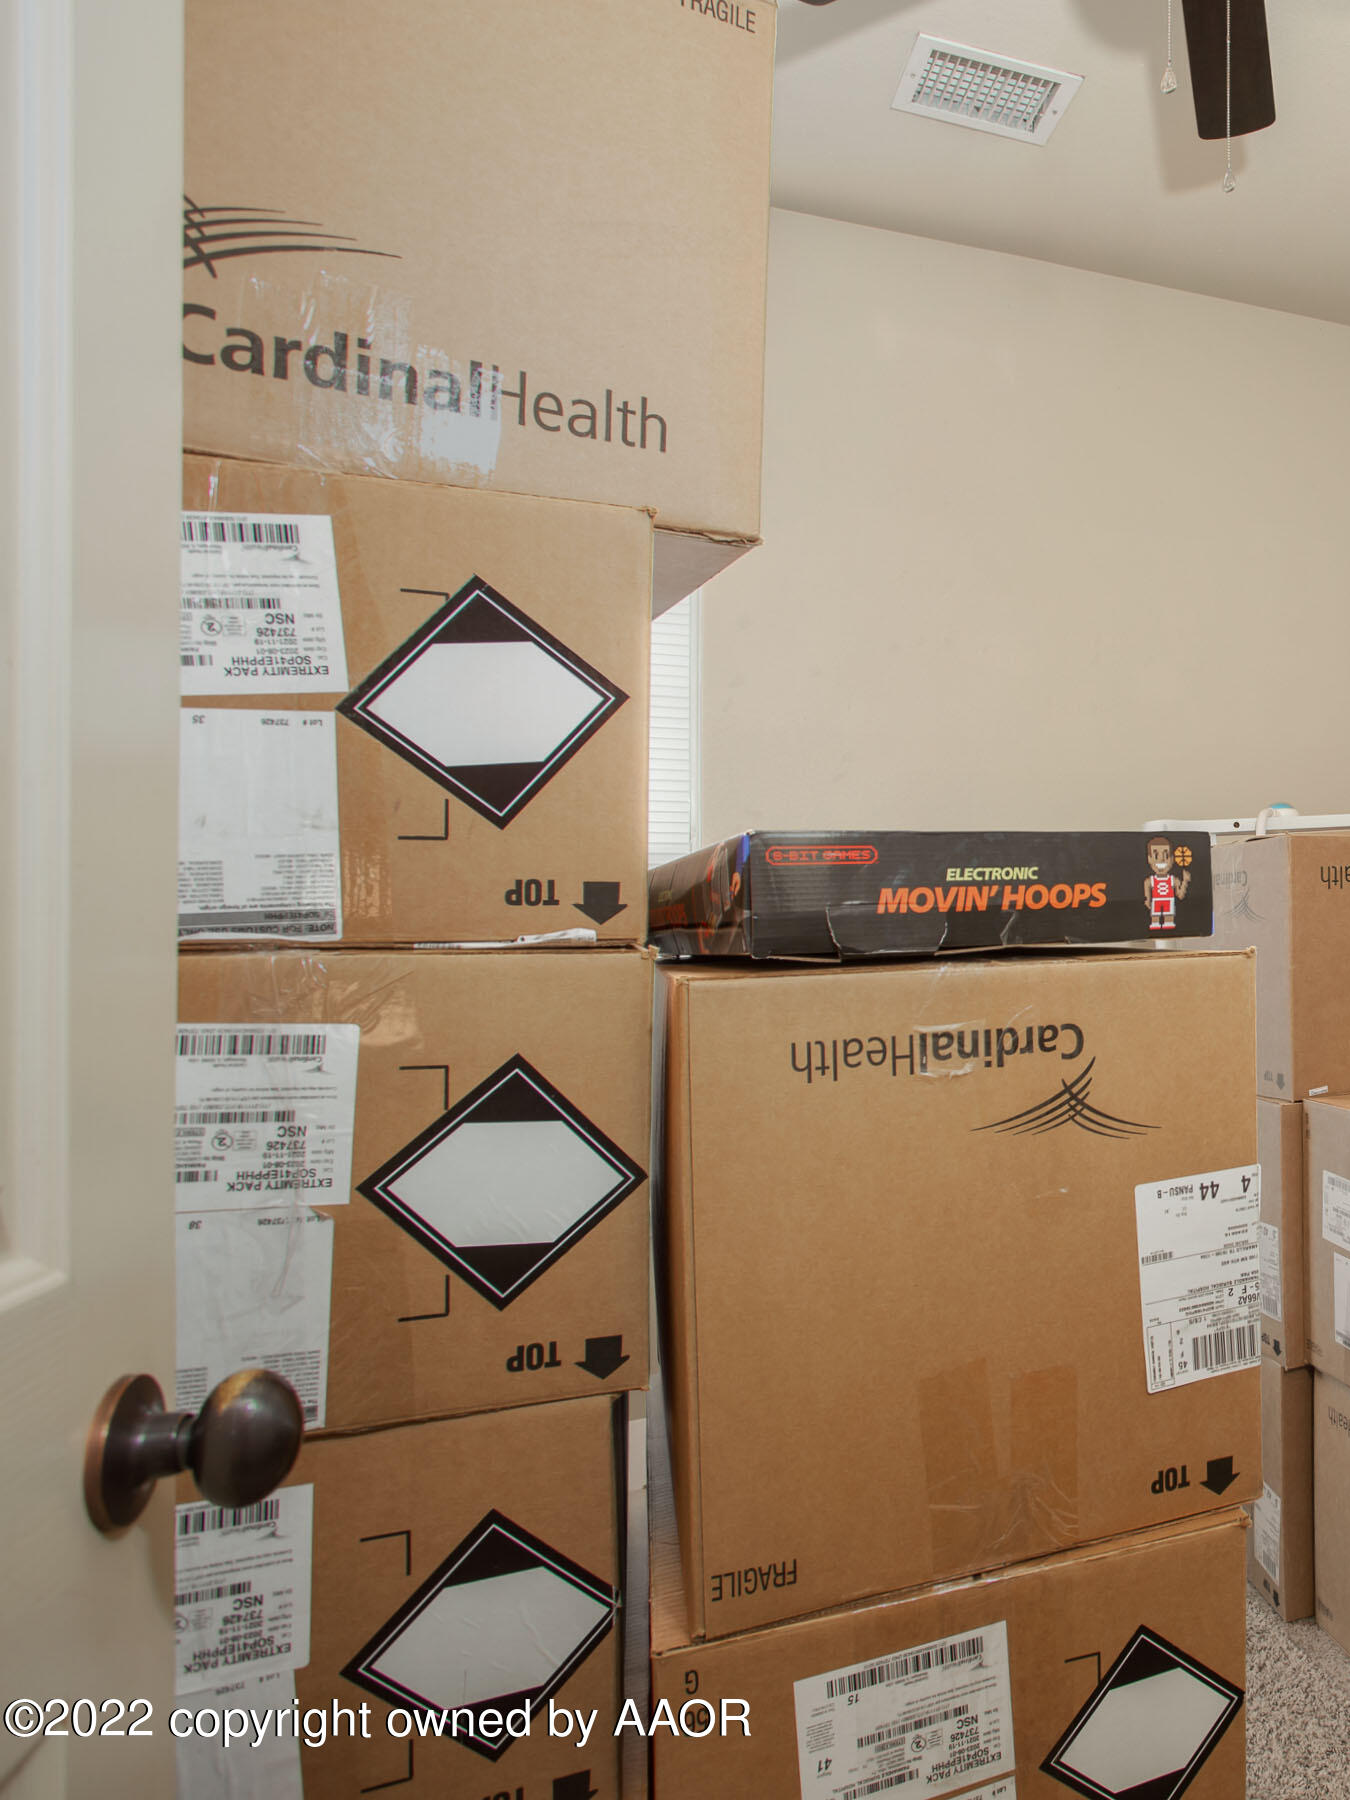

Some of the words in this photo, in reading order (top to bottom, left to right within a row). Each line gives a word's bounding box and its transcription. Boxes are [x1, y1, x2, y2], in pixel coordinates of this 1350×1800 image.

[182, 303, 668, 454] CardinalHealth
[265, 613, 295, 625] NSC
[256, 627, 296, 637] 737426
[231, 655, 312, 666] SOP41EPPHH
[223, 666, 258, 677] PACK
[262, 665, 329, 676] EXTREMITY
[945, 866, 1039, 881] ELECTRONIC
[504, 878, 560, 907] TOP
[876, 884, 999, 914] MOVIN'
[1001, 882, 1108, 912] HOOPS
[791, 1023, 1085, 1085] CardinalHealth
[277, 1125, 307, 1138] NSC
[217, 1137, 227, 1147] 2
[266, 1139, 307, 1151] 737426
[236, 1168, 317, 1182] SOP41EPPHH
[227, 1181, 262, 1192] PACK
[265, 1177, 333, 1190] EXTREMITY
[1199, 1180, 1219, 1201] 44
[1240, 1175, 1251, 1194] 4
[505, 1340, 562, 1373] TOP
[1150, 1465, 1190, 1495] TOP
[711, 1558, 798, 1602] FRAGILE
[233, 1594, 264, 1611] NSC
[222, 1642, 292, 1666] EXTREMITY
[183, 1657, 218, 1674] PACK
[685, 1669, 700, 1695] G
[847, 1694, 860, 1705] 15
[956, 1714, 978, 1729] NSC
[950, 1726, 979, 1741] 737426
[914, 1740, 922, 1749] 2
[817, 1757, 832, 1772] 41
[931, 1746, 990, 1773] SOP41EPPHH
[953, 1751, 1002, 1775] EXTREMITY
[925, 1767, 951, 1784] PACK
